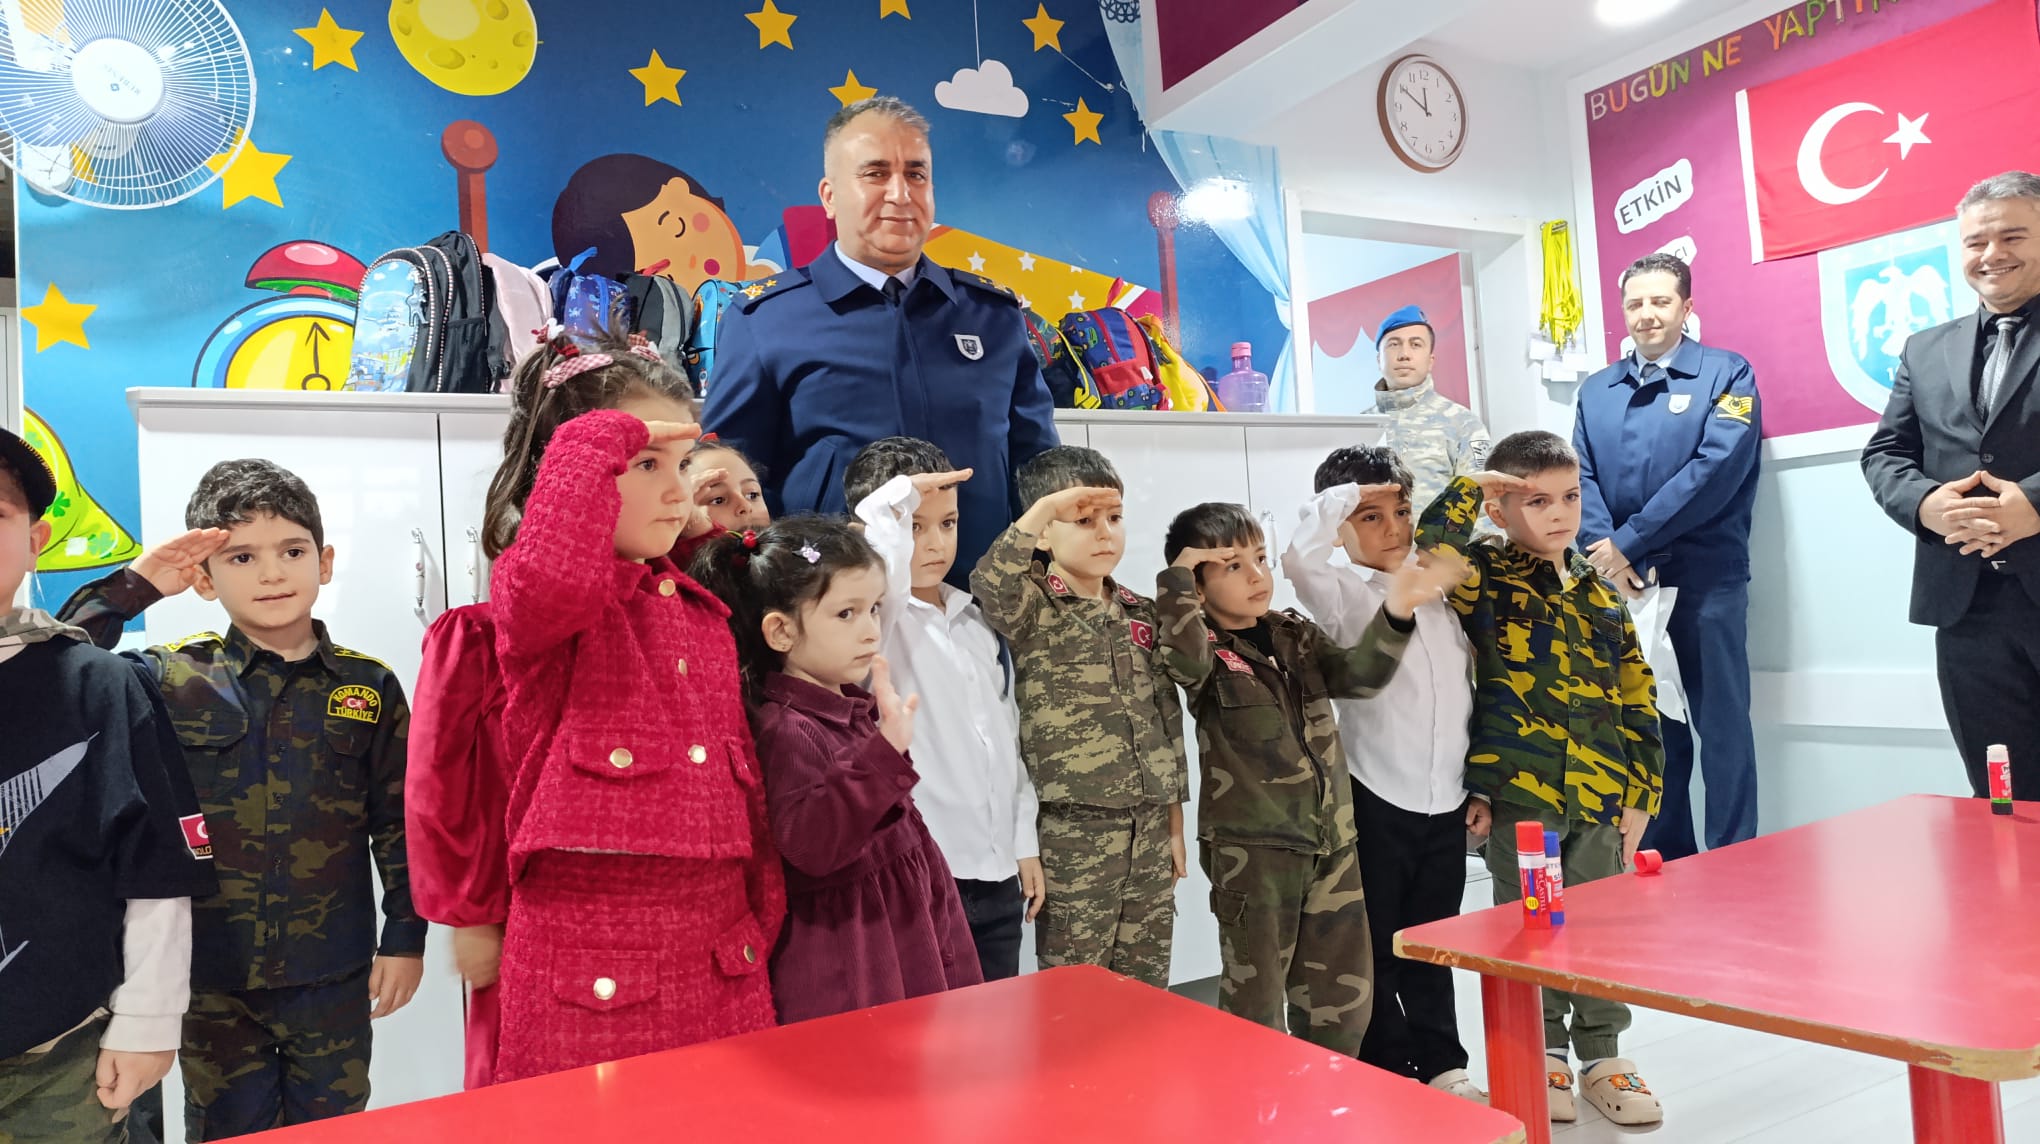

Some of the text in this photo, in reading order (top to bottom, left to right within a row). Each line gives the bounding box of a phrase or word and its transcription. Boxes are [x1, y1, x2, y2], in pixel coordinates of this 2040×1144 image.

[1590, 0, 1898, 120] BUGÜN NE YAPT
[1619, 175, 1682, 225] ETKİN
[333, 687, 378, 707] KOMANDO
[335, 706, 374, 721] TÜRKİYE
